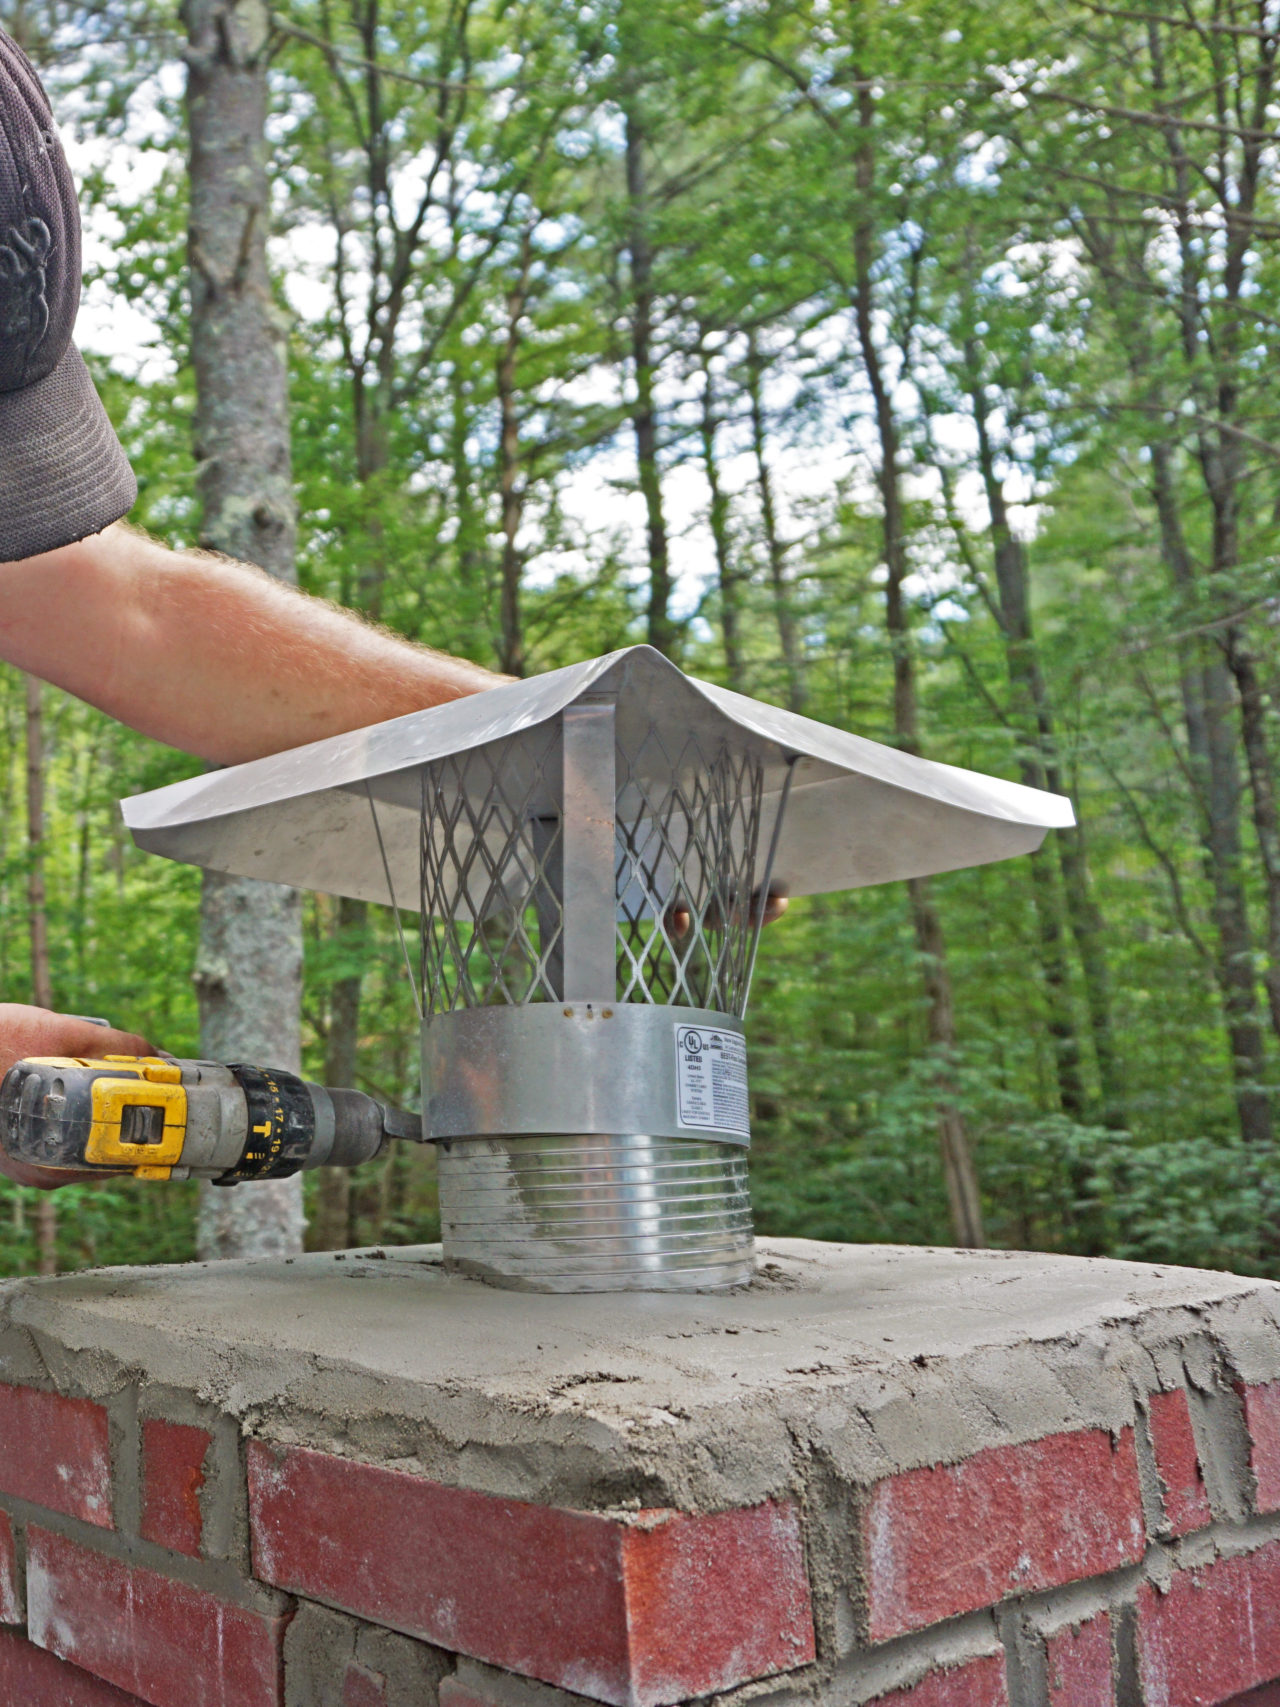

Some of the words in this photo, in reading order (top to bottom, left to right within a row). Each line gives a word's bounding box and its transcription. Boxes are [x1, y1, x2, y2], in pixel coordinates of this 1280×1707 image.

[688, 1035, 699, 1050] UL
[684, 1055, 703, 1063] LISTED
[267, 1080, 279, 1093] 15
[274, 1108, 284, 1123] 17
[271, 1138, 281, 1152] 19
